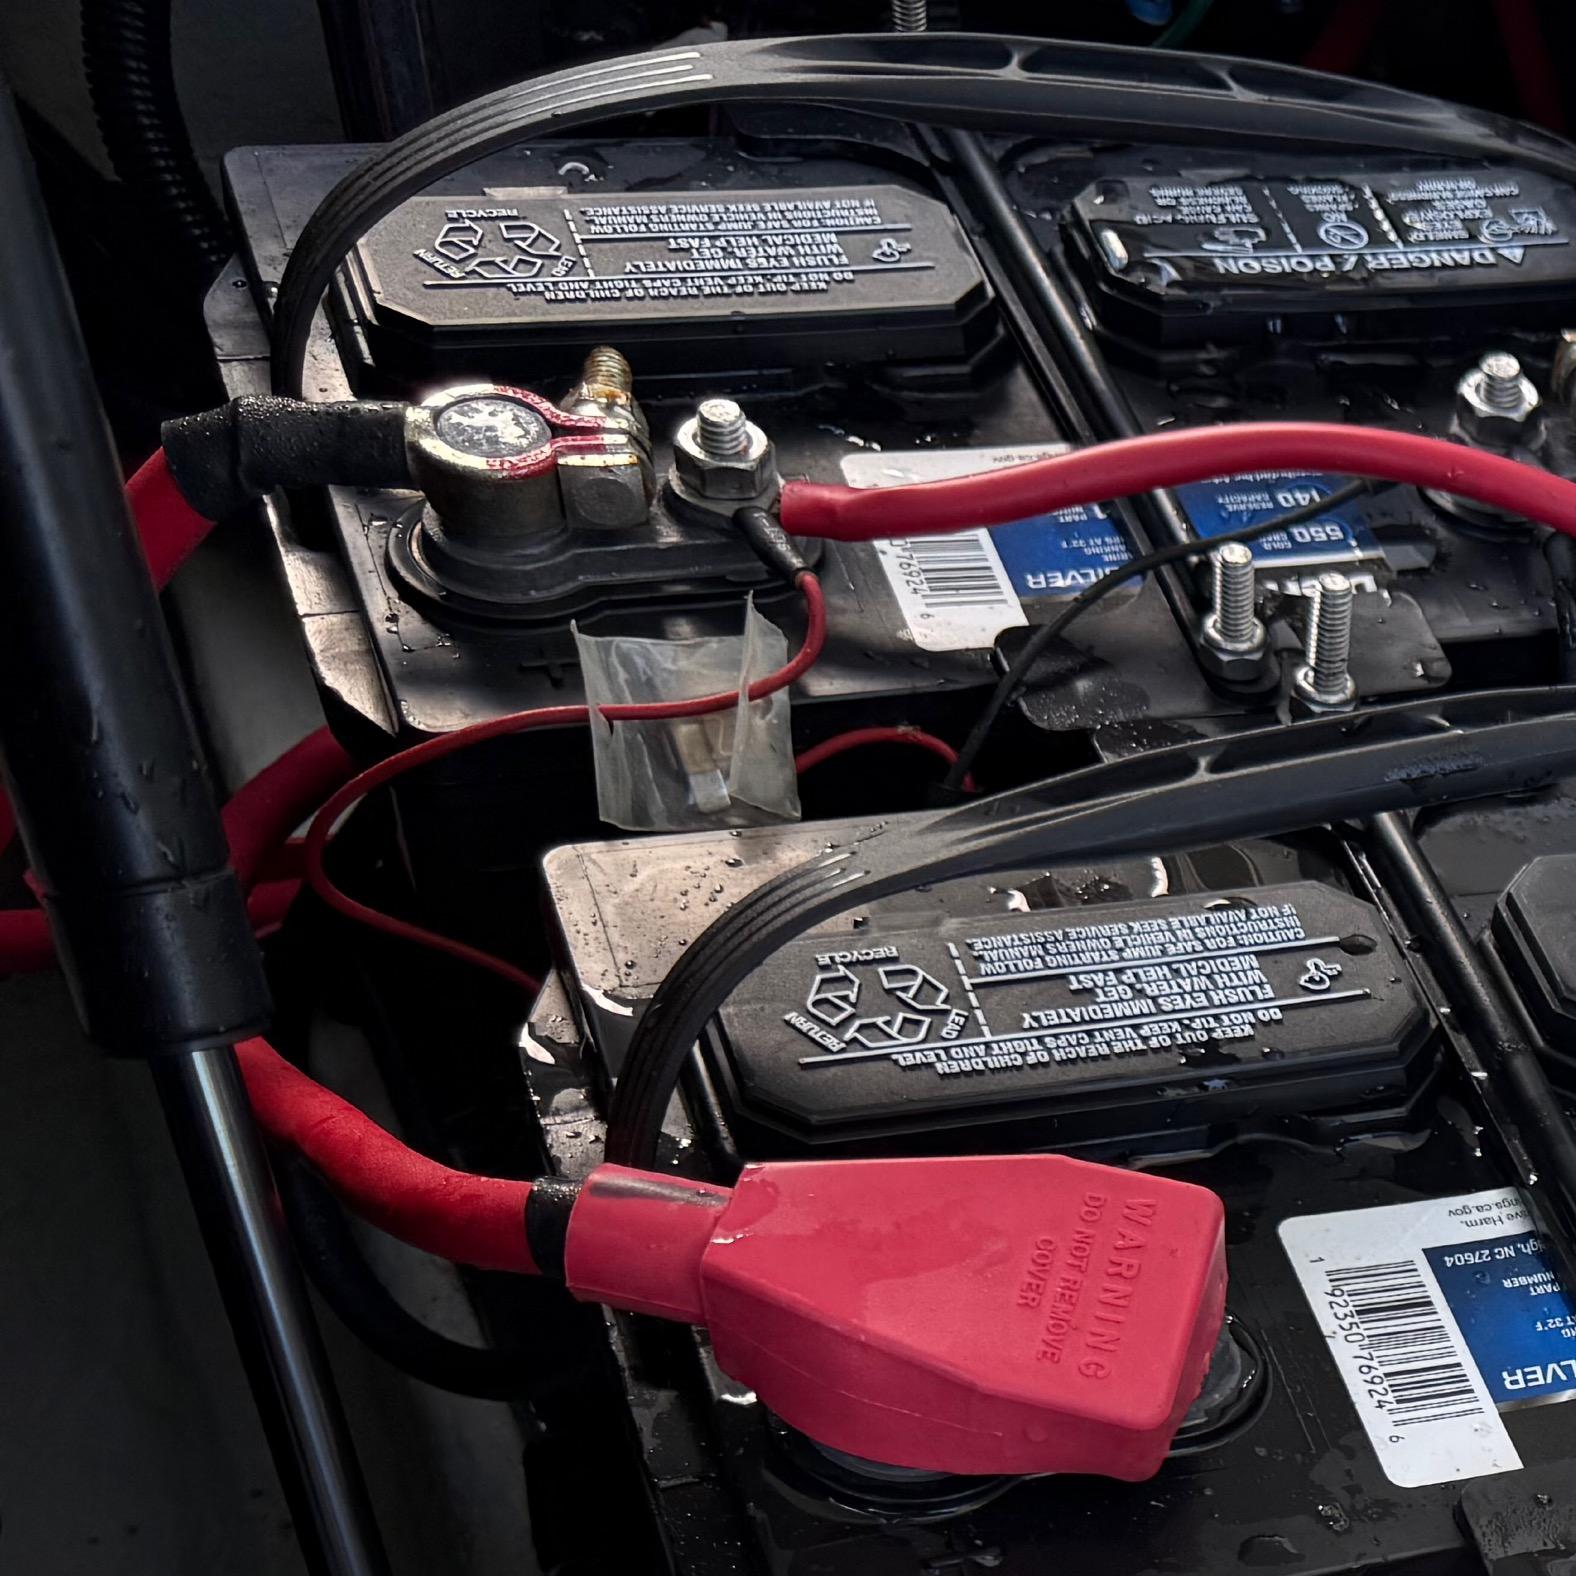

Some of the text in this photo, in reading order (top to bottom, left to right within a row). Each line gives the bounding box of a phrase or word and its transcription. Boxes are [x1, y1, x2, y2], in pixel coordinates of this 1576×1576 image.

[445, 207, 518, 218] RECYCLE
[666, 232, 836, 247] MEDICAL HELP FAST
[689, 243, 842, 258] WITH GET
[412, 248, 465, 277] RETURN
[623, 253, 848, 271] FLUSH EYES IMMEDIATELY
[1213, 247, 1494, 273] DANGER POISON
[1276, 488, 1320, 506] 140
[1291, 524, 1342, 542] 550
[1169, 908, 1246, 928] AVAILABLE
[1247, 904, 1282, 919] NOT
[1282, 903, 1296, 915] IF
[1066, 921, 1129, 940] SERVICE
[1131, 917, 1166, 932] SEEK
[1176, 927, 1192, 940] IN
[1193, 915, 1299, 938] INSTRUCTIONS
[1046, 935, 1110, 954] OWNERS
[1112, 928, 1174, 947] VEHICLE
[815, 946, 898, 965] RECYCLE
[978, 926, 1304, 975] CAUTION: FOR SAFE JUMP STARTING FOLLOW
[1066, 953, 1258, 989] MEDICAL HELP FAST
[1093, 968, 1266, 1002] WITH GET
[1020, 984, 1274, 1028] FLUSH EYES IMMEDIATELY
[1257, 1006, 1280, 1021] DO
[940, 1009, 967, 1039] LEAD
[1220, 1010, 1254, 1026] NOT
[782, 1011, 845, 1051] RETURN
[1092, 1024, 1135, 1041] VENT
[1138, 1019, 1178, 1036] KEEP
[988, 1036, 1040, 1054] TIGHT
[1044, 1030, 1087, 1047] CAPS
[933, 1023, 1253, 1074] KEEP OUT OF THE REACH OF CHILDREN
[948, 1043, 985, 1059] AND
[1459, 1214, 1504, 1230] Harm.
[1442, 1244, 1514, 1267] NC 27604
[1016, 1234, 1057, 1311] COVER
[1035, 1190, 1106, 1365] DO NOT REMOVE
[1501, 1270, 1555, 1288] NUMBER
[1076, 1192, 1158, 1383] WARNING
[1528, 1281, 1560, 1296] PART
[1323, 1286, 1365, 1345] 92350
[1355, 1350, 1389, 1411] 76924
